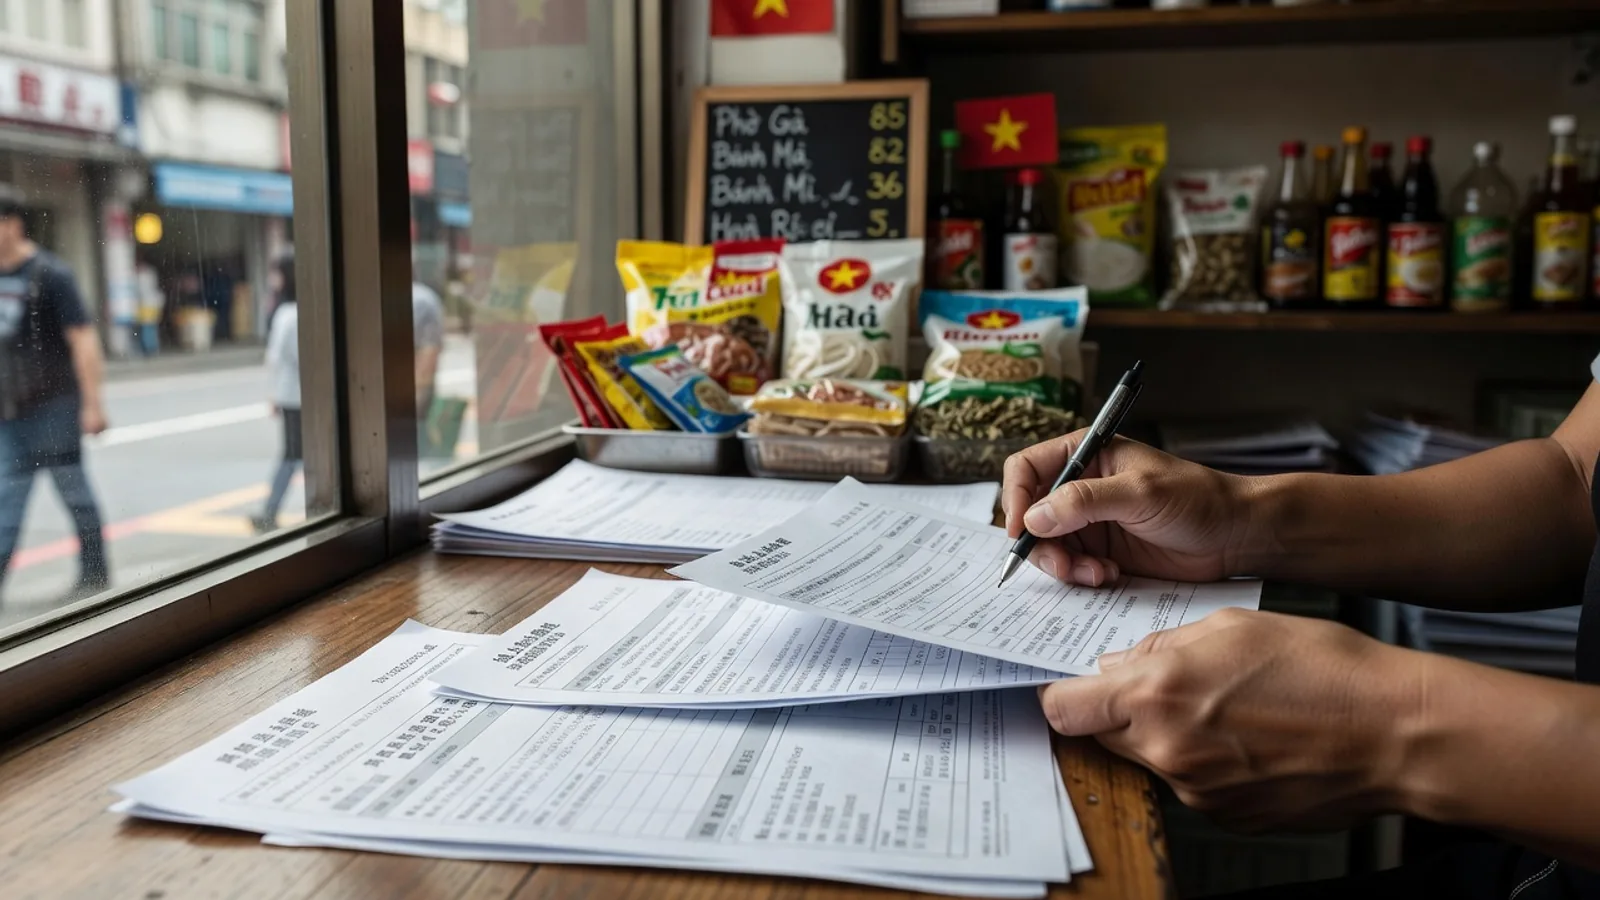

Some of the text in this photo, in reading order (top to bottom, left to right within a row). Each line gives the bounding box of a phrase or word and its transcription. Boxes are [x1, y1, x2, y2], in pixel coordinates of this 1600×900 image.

[869, 101, 906, 131] 85
[868, 136, 905, 164] 82
[866, 170, 903, 199] 36
